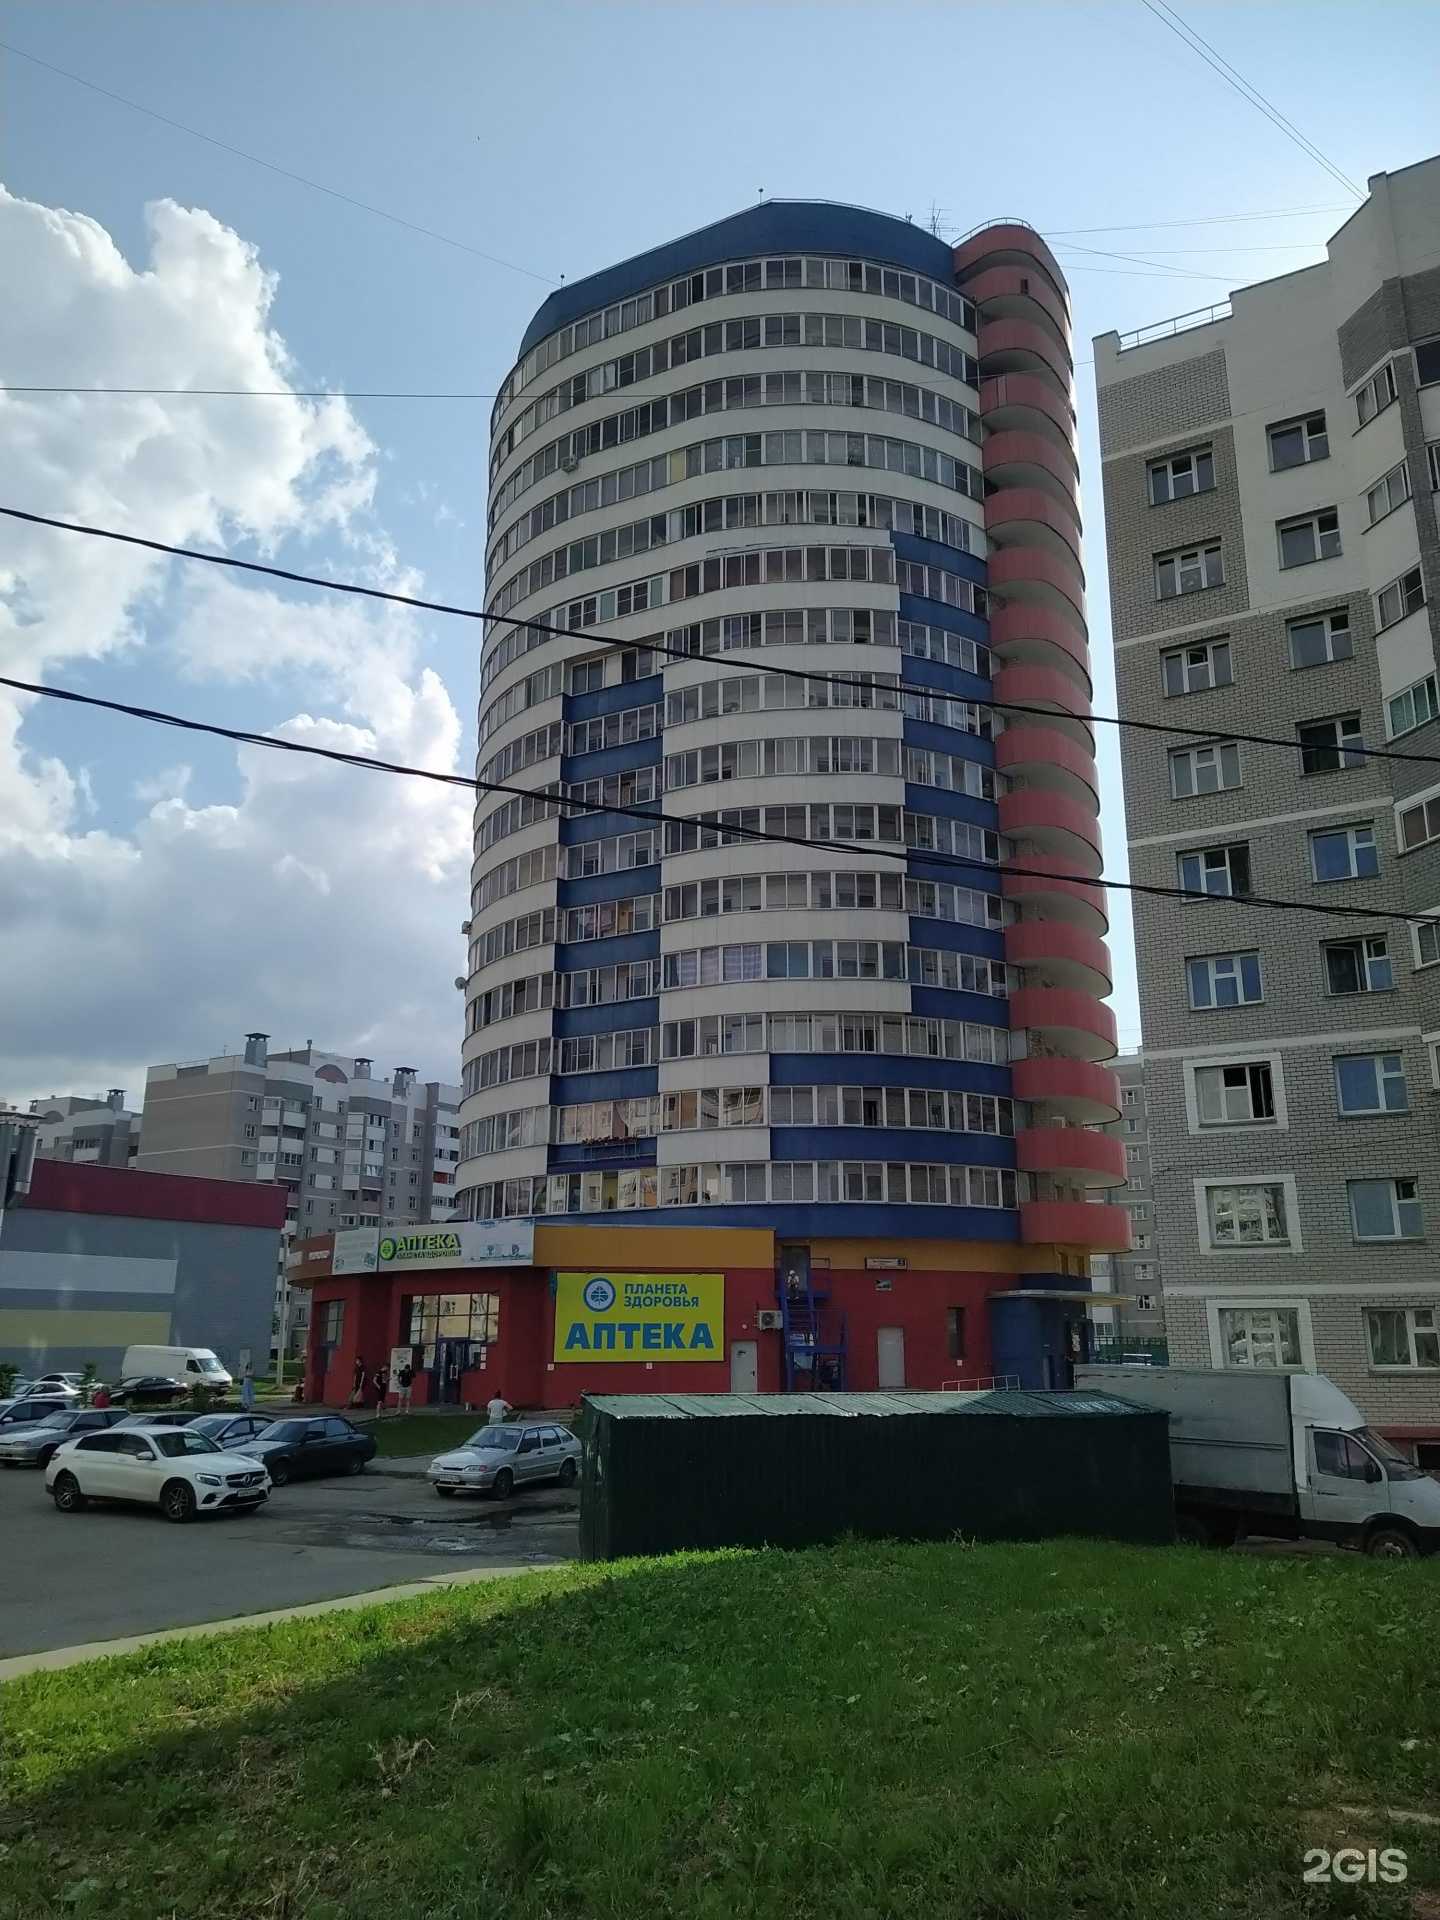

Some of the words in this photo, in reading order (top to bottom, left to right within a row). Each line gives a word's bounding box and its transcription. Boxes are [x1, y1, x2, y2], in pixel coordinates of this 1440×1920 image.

[397, 1233, 462, 1251] АПТЕКА
[624, 1283, 688, 1295] ПЛАНЕТА
[623, 1296, 699, 1308] ЗДОРОВЬЯ
[564, 1322, 715, 1350] АПТЕКА
